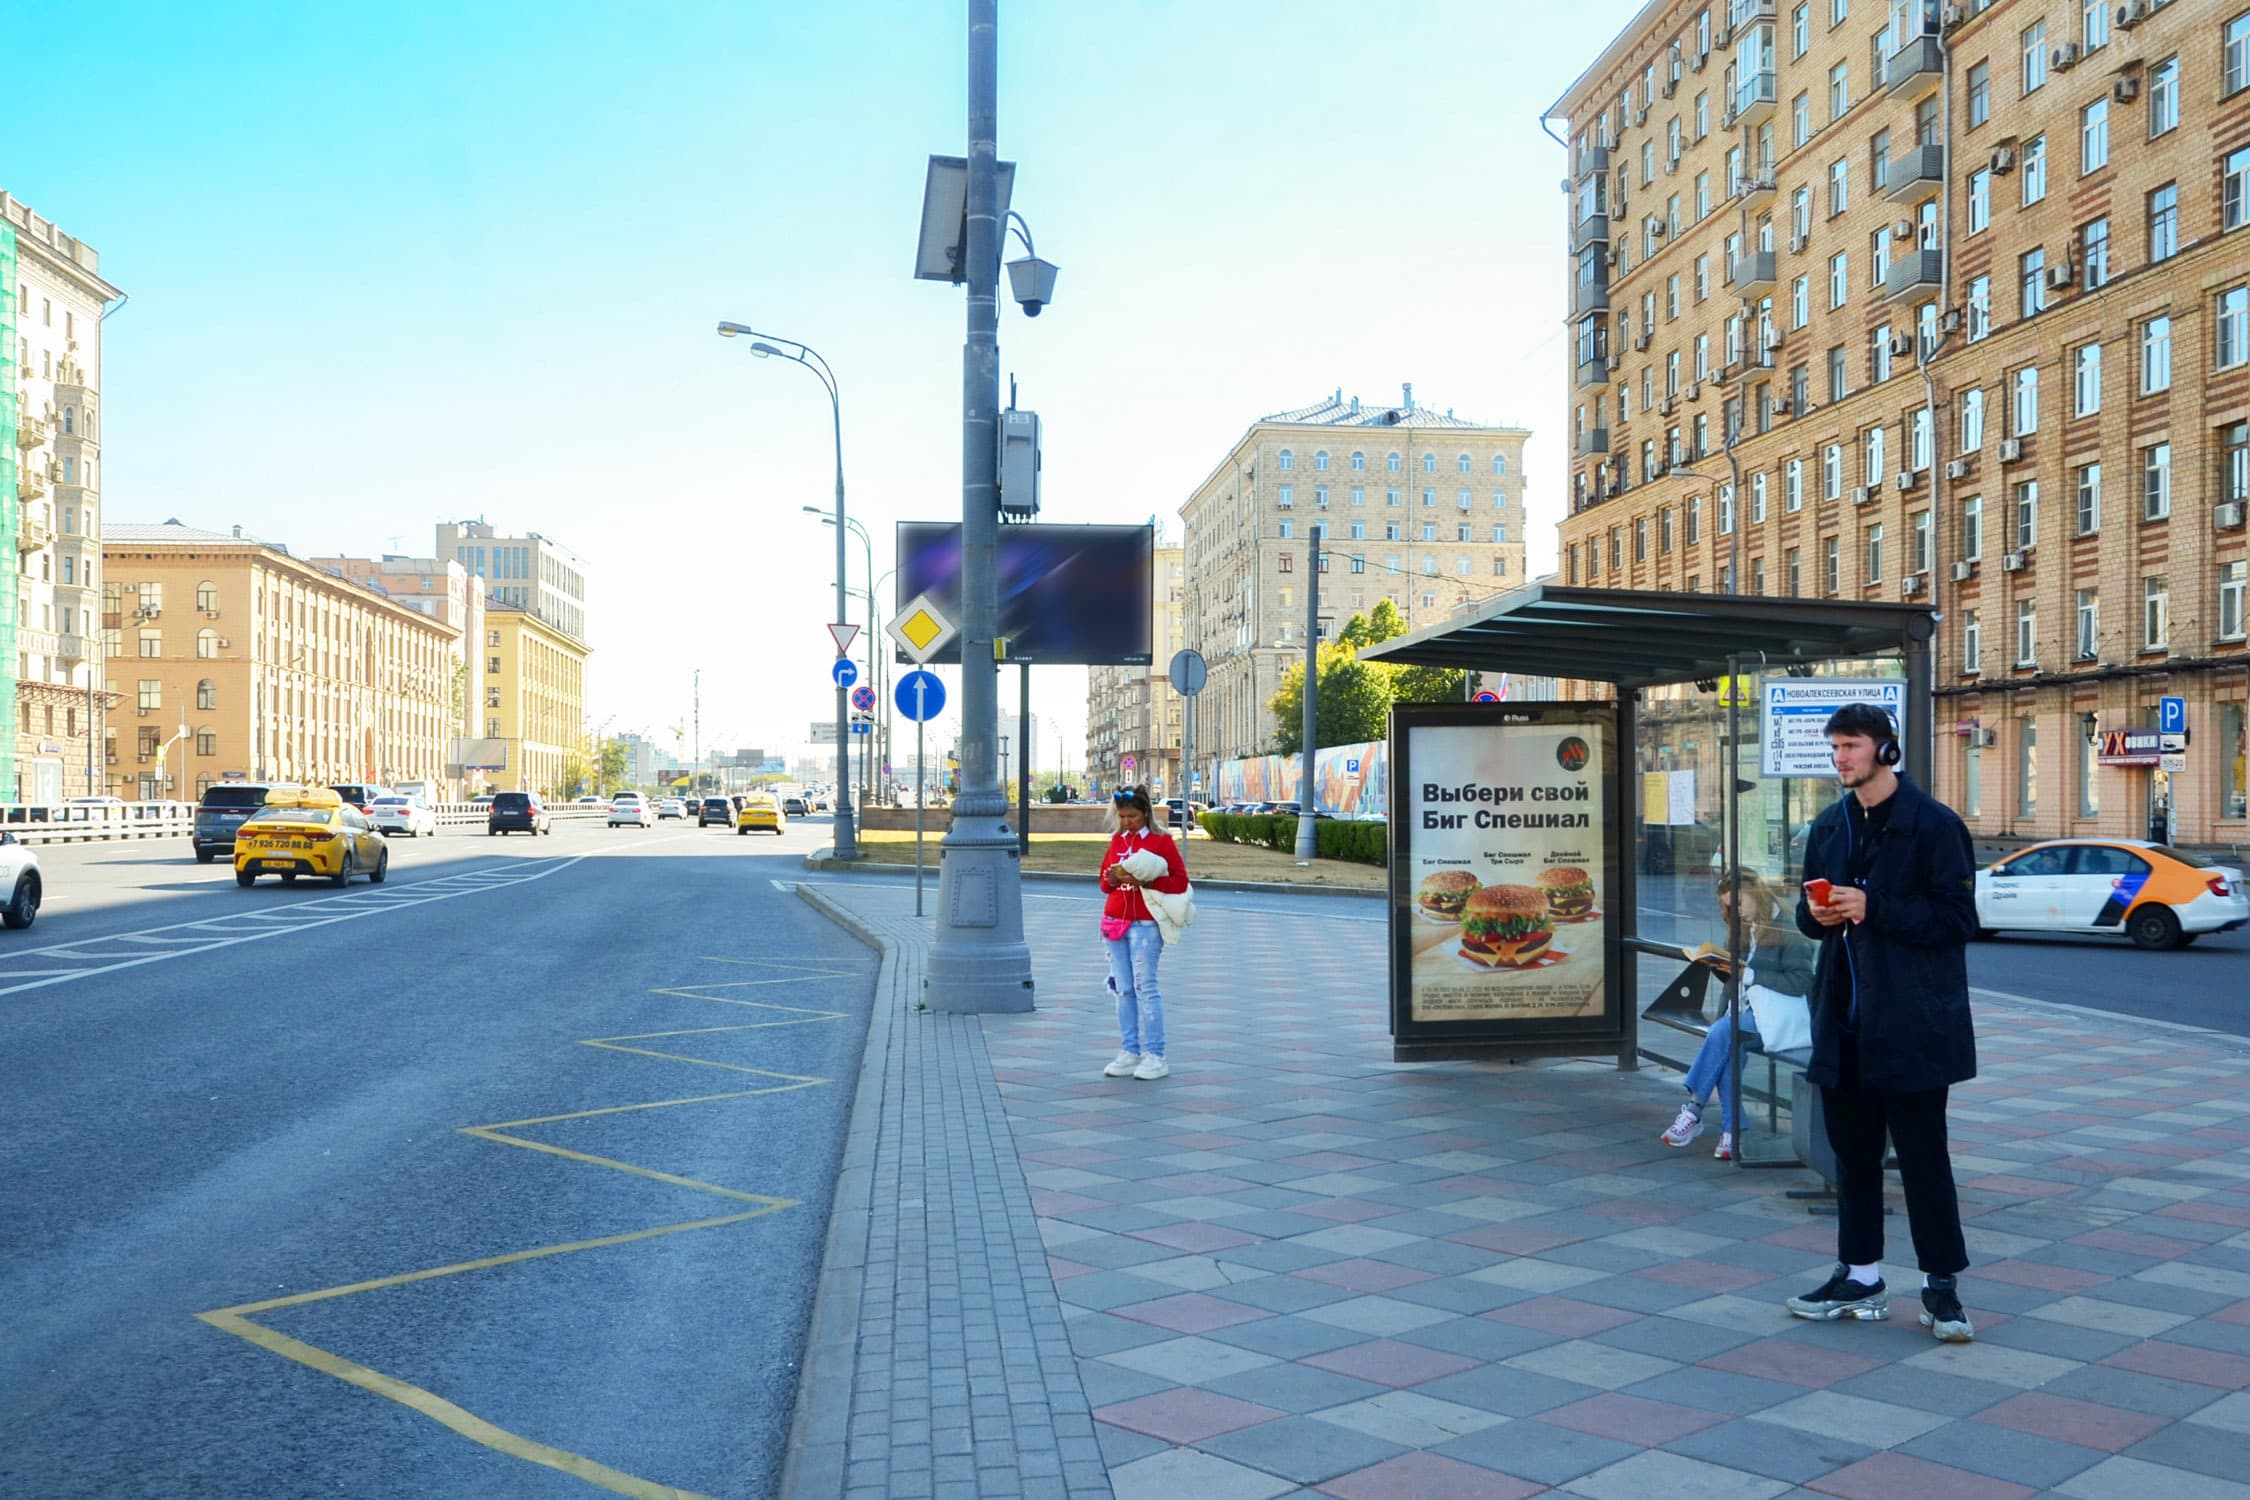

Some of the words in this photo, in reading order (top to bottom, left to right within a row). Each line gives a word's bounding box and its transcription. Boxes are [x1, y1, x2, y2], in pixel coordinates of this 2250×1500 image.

[1786, 688, 1857, 699] НОВОАЛЕКСЕЕВСКАЯ
[1858, 688, 1881, 698] УЛИЦА
[2166, 701, 2179, 729] P
[1348, 760, 1357, 771] P
[1423, 783, 1524, 806] Выбери
[1531, 781, 1589, 801] свой
[1423, 810, 1468, 829] Биг
[1474, 809, 1590, 829] Спешиал
[248, 840, 257, 848] +7
[258, 840, 273, 848] 926
[275, 839, 290, 848] 720
[1550, 849, 1582, 858] Двойной
[1490, 858, 1503, 866] Три
[1504, 858, 1524, 866] Сыра
